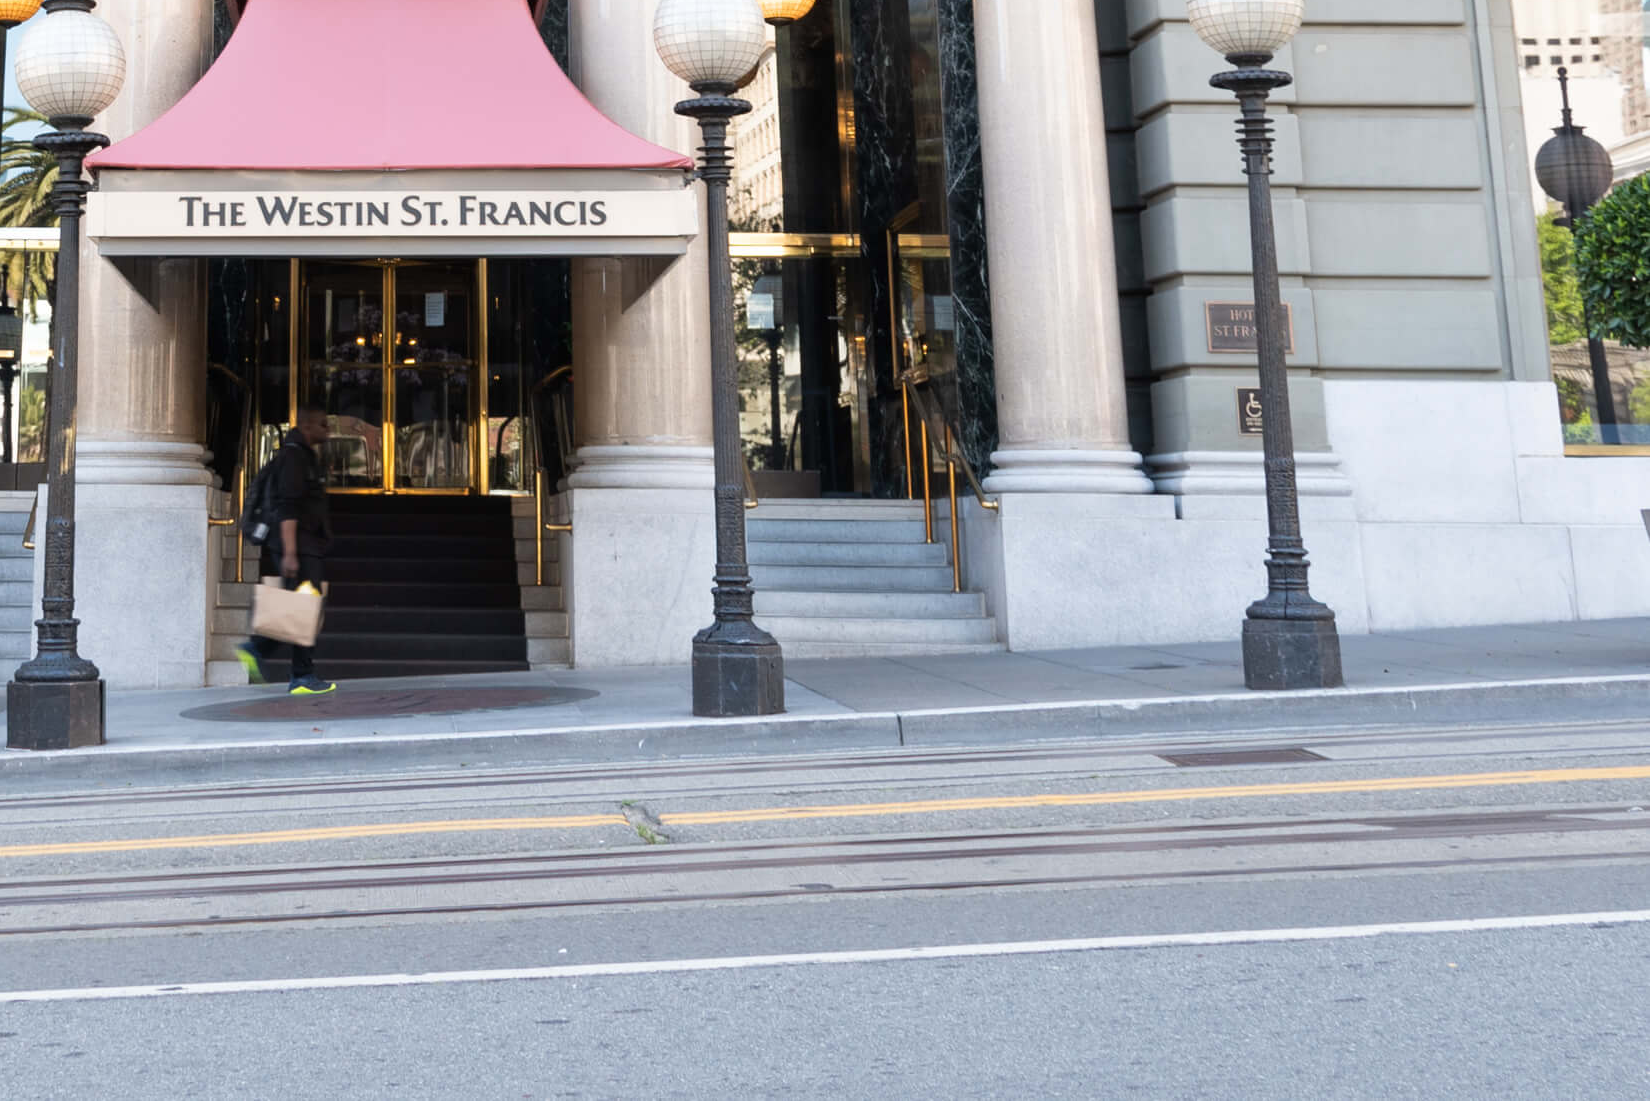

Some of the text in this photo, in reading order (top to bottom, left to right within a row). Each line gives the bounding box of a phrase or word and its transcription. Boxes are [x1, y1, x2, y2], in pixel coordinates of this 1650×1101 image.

[180, 195, 607, 227] THE WESTIN ST. FRANCIS
[1230, 309, 1255, 321] HOT
